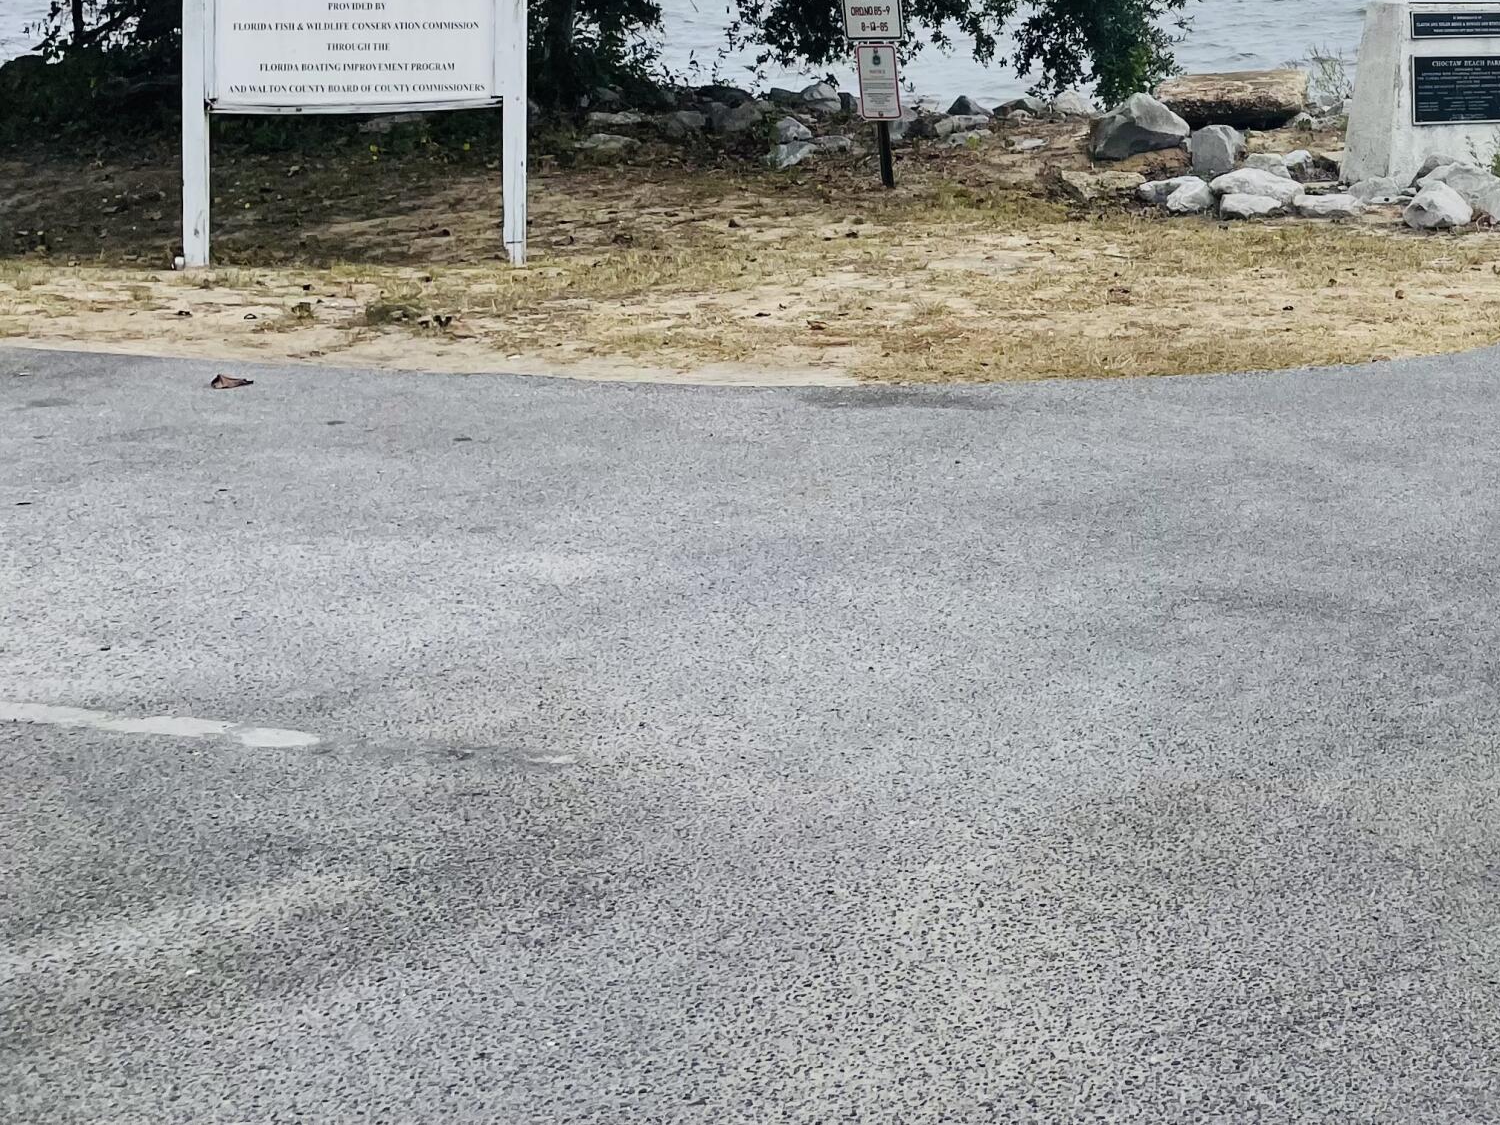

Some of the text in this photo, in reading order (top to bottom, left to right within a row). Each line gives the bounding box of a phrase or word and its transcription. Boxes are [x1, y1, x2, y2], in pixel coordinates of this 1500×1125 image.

[328, 2, 386, 11] PROVIDED BY
[233, 21, 479, 31] FLORIDA FISH & WILDLIFE CONSERVATION COMMISSION
[326, 43, 390, 51] THROUGH THE
[260, 62, 455, 72] FLORIDA BOATING IMPROVEMENT PROGRAM
[229, 83, 486, 93] AND WALTON COUNTY BOARD OF COUNTY COMMISSIONERS
